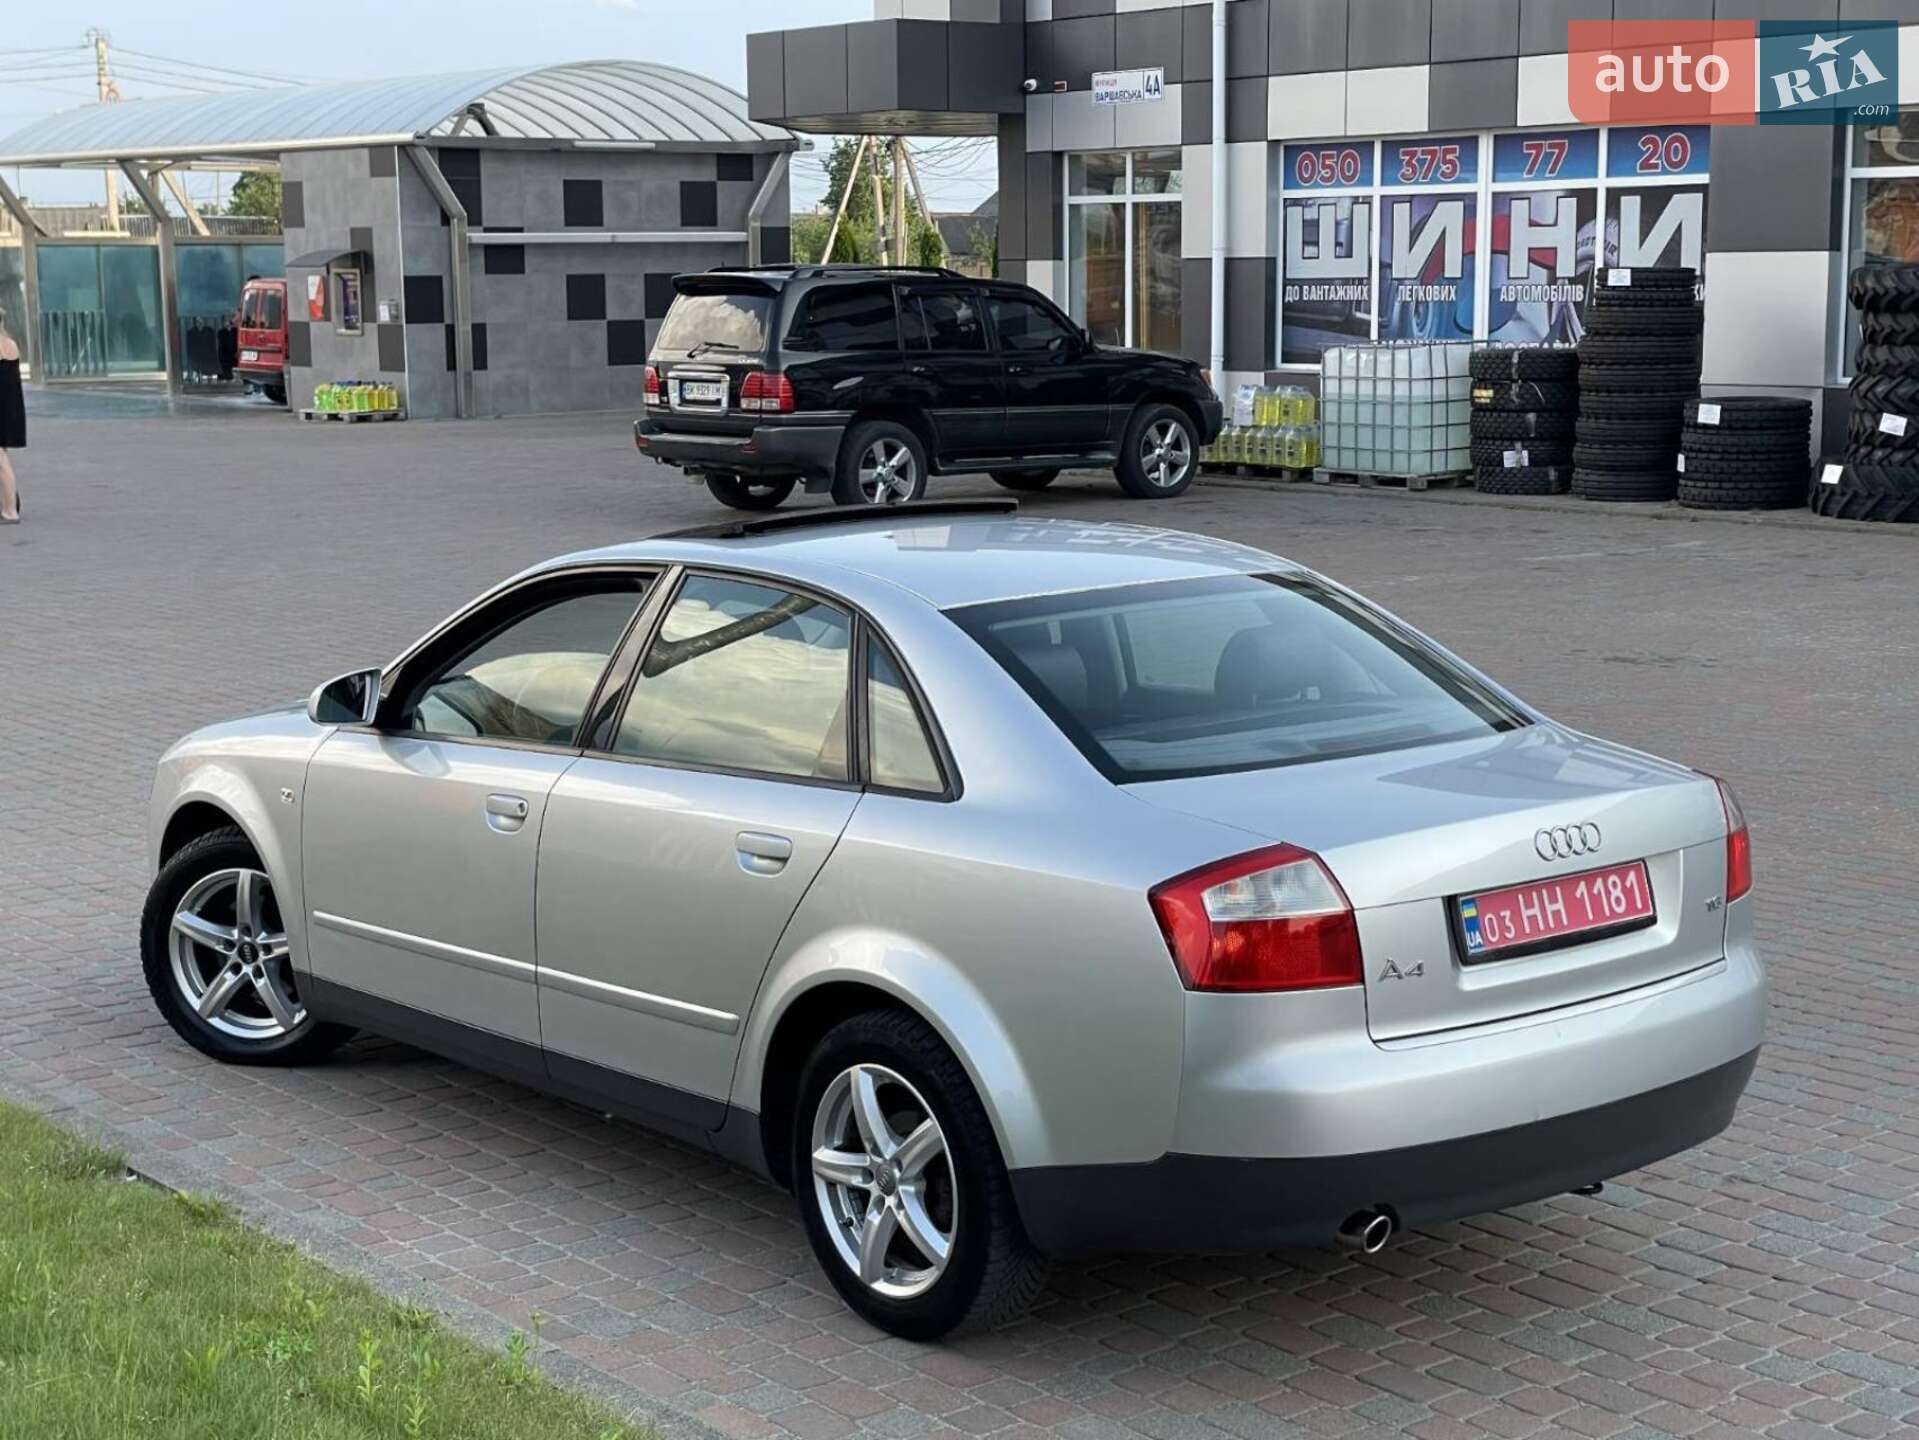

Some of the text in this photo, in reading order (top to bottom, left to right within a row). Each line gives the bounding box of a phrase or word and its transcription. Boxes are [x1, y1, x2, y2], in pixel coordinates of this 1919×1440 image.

[1296, 132, 1691, 186] 050 375 77 20
[1286, 193, 1703, 279] ШИНИ
[1285, 284, 1584, 302] ДО ВАНТАЖНИХ ЛЕГКОВИХ АВТОМОБІЛІВ
[1484, 870, 1643, 943] 03 HH 1181
[1467, 932, 1484, 948] UA
[1376, 957, 1425, 983] A4
